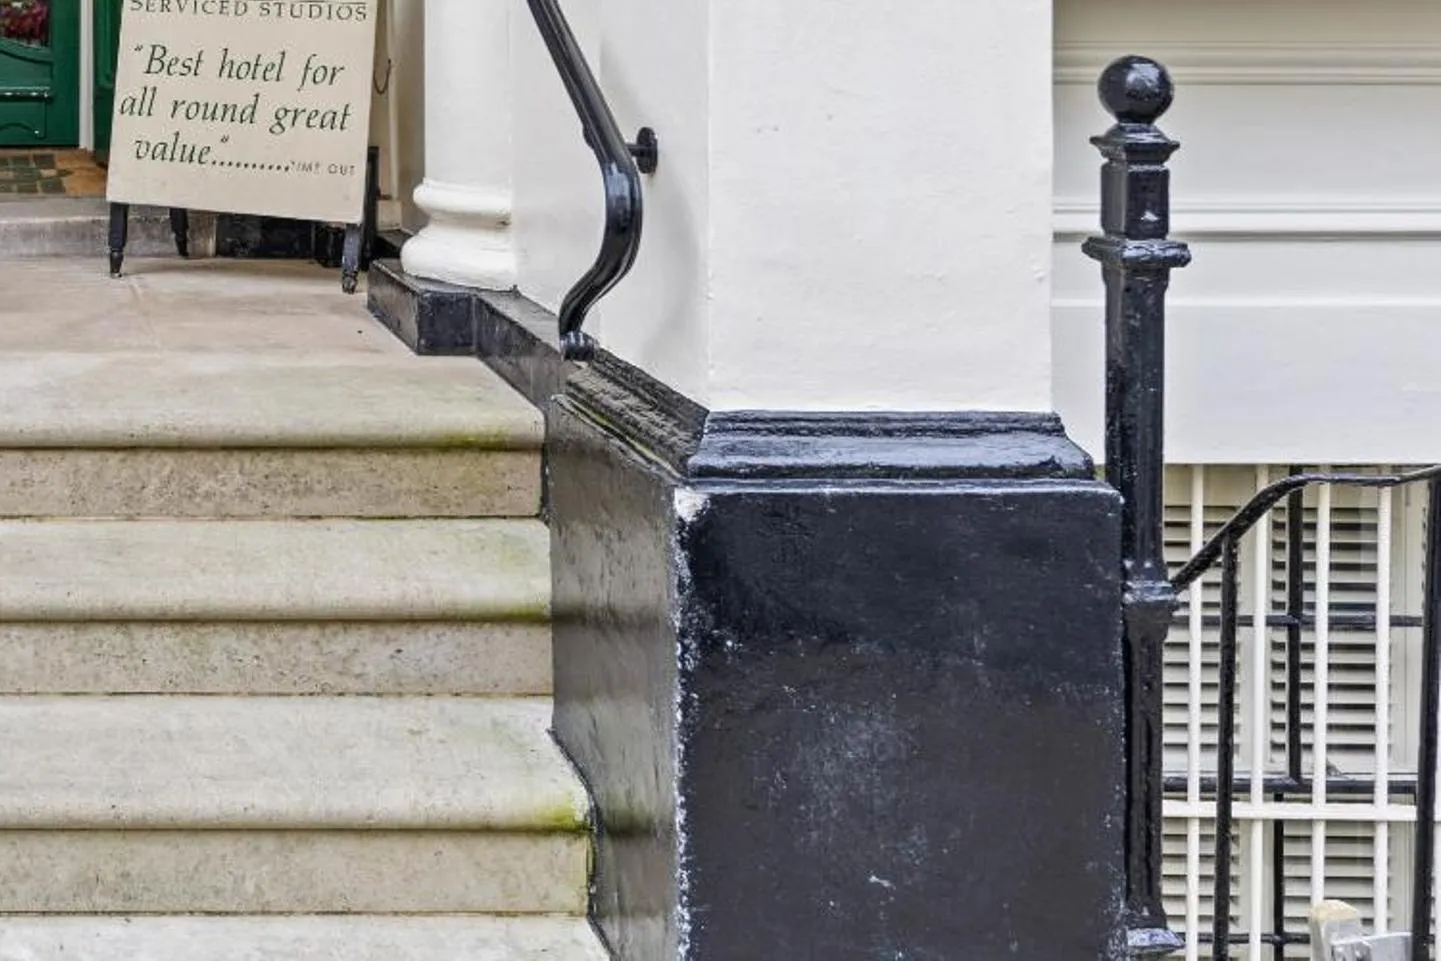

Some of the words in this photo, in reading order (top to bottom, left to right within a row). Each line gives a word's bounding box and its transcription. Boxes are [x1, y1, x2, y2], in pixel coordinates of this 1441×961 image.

[260, 0, 368, 22] STUDIOS
[219, 48, 285, 82] hotel
[298, 54, 345, 92] for
[120, 86, 157, 117] all
[170, 93, 260, 125] round
[269, 102, 353, 135] great
